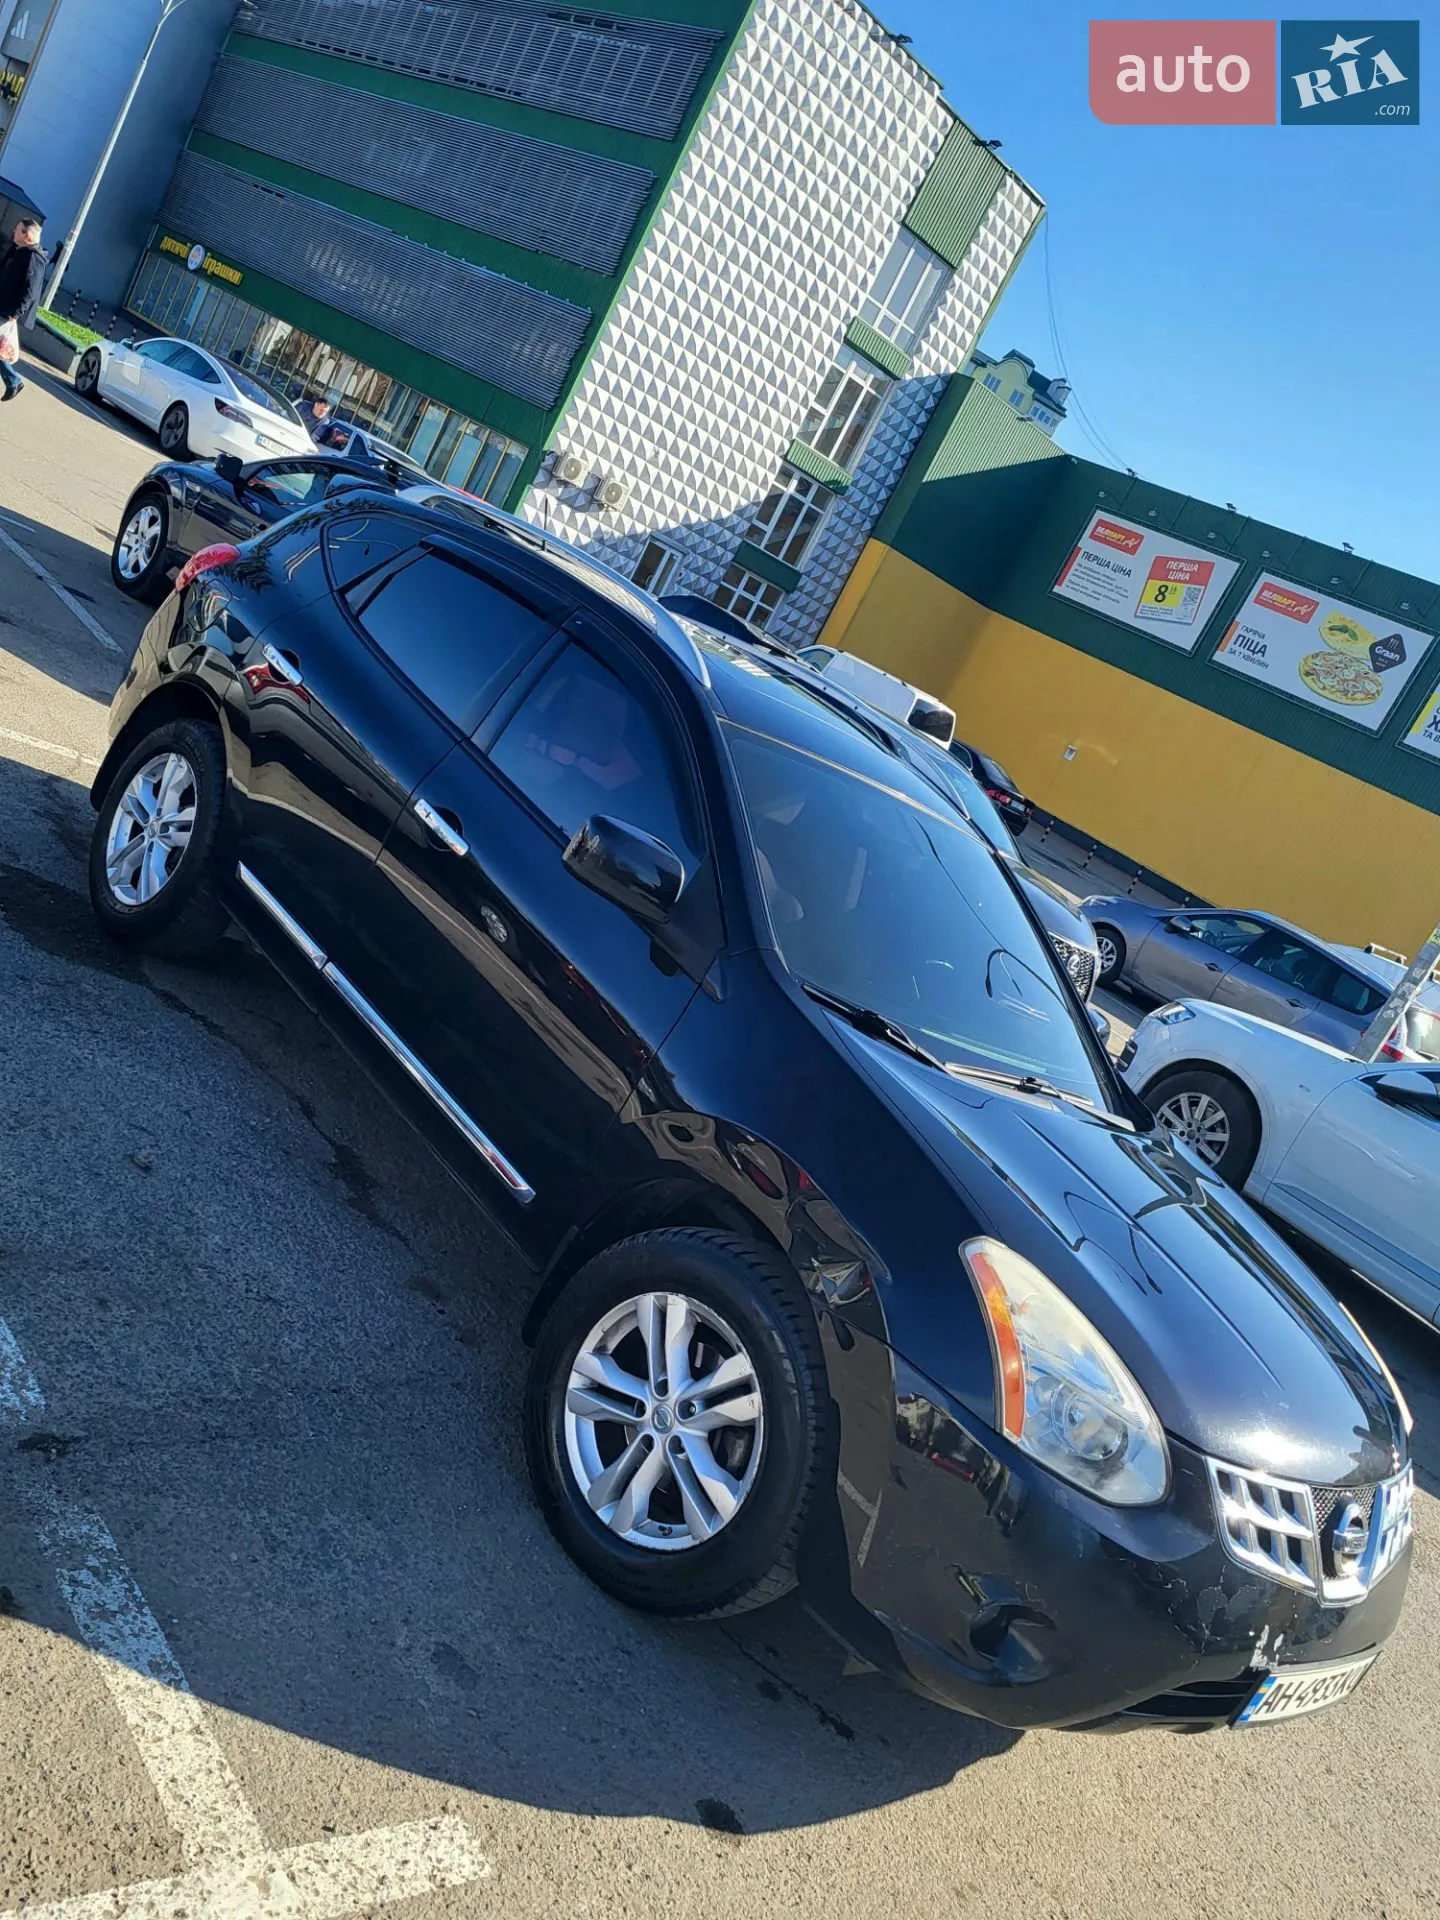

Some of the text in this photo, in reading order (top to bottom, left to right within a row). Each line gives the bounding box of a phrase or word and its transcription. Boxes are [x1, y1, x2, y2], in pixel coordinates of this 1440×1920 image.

[202, 251, 244, 285] іграшки
[1081, 551, 1132, 578] ПЕРША ЦІНА
[1166, 560, 1199, 572] ПЕРША
[1168, 571, 1190, 581] ЦІНА
[1154, 584, 1169, 603] 8
[1241, 625, 1266, 640] ГАРЯЧА
[1233, 634, 1268, 658] ПІЦА
[1375, 645, 1400, 662] Graan
[1241, 653, 1269, 669] ХВИЛИН
[1422, 730, 1440, 744] ТА В
